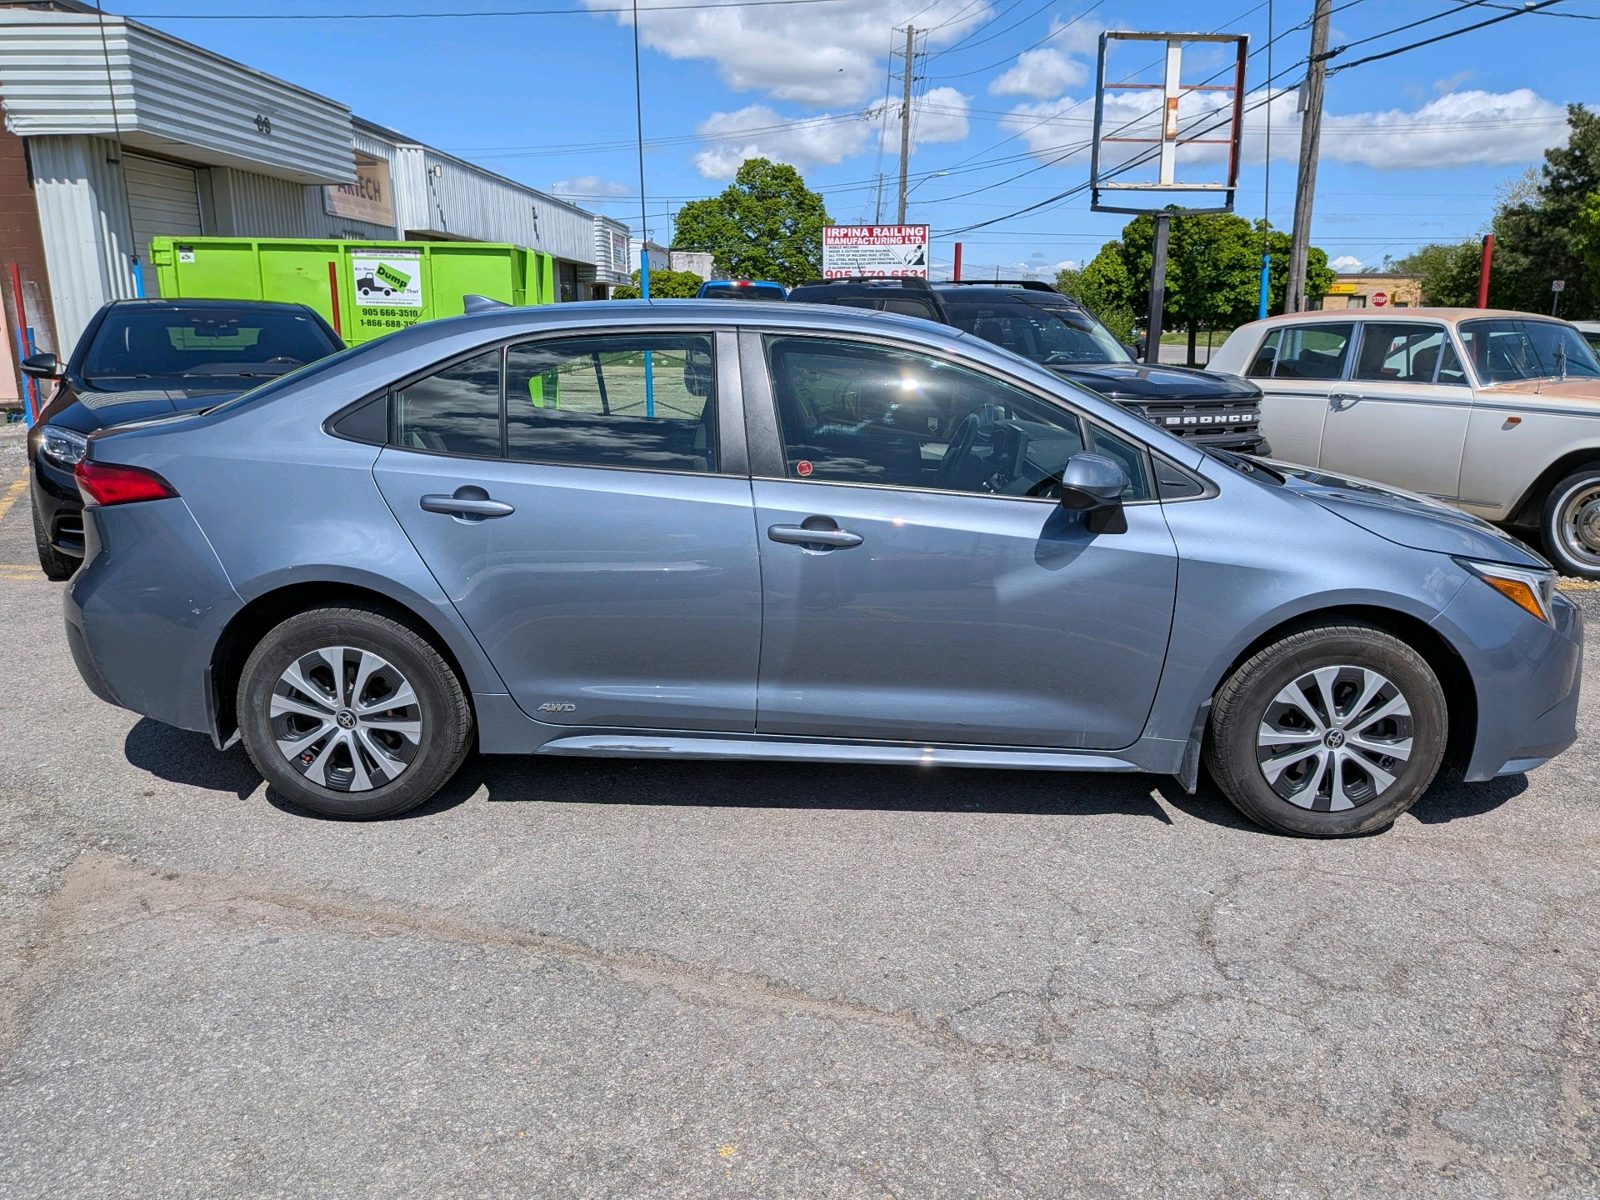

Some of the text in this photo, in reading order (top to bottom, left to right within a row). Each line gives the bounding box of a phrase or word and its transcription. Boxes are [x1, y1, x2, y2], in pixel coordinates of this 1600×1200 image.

[827, 227, 924, 237] IRPINA RAILING
[826, 236, 924, 245] MANUFACTURING LTD.
[376, 266, 408, 288] Dump
[825, 270, 852, 279] 905
[891, 270, 926, 278] 6531
[362, 308, 418, 317] 905 666-3510
[360, 320, 419, 328] 1-866-688-35
[1165, 414, 1253, 424] BRONCO
[537, 703, 577, 712] AWD
